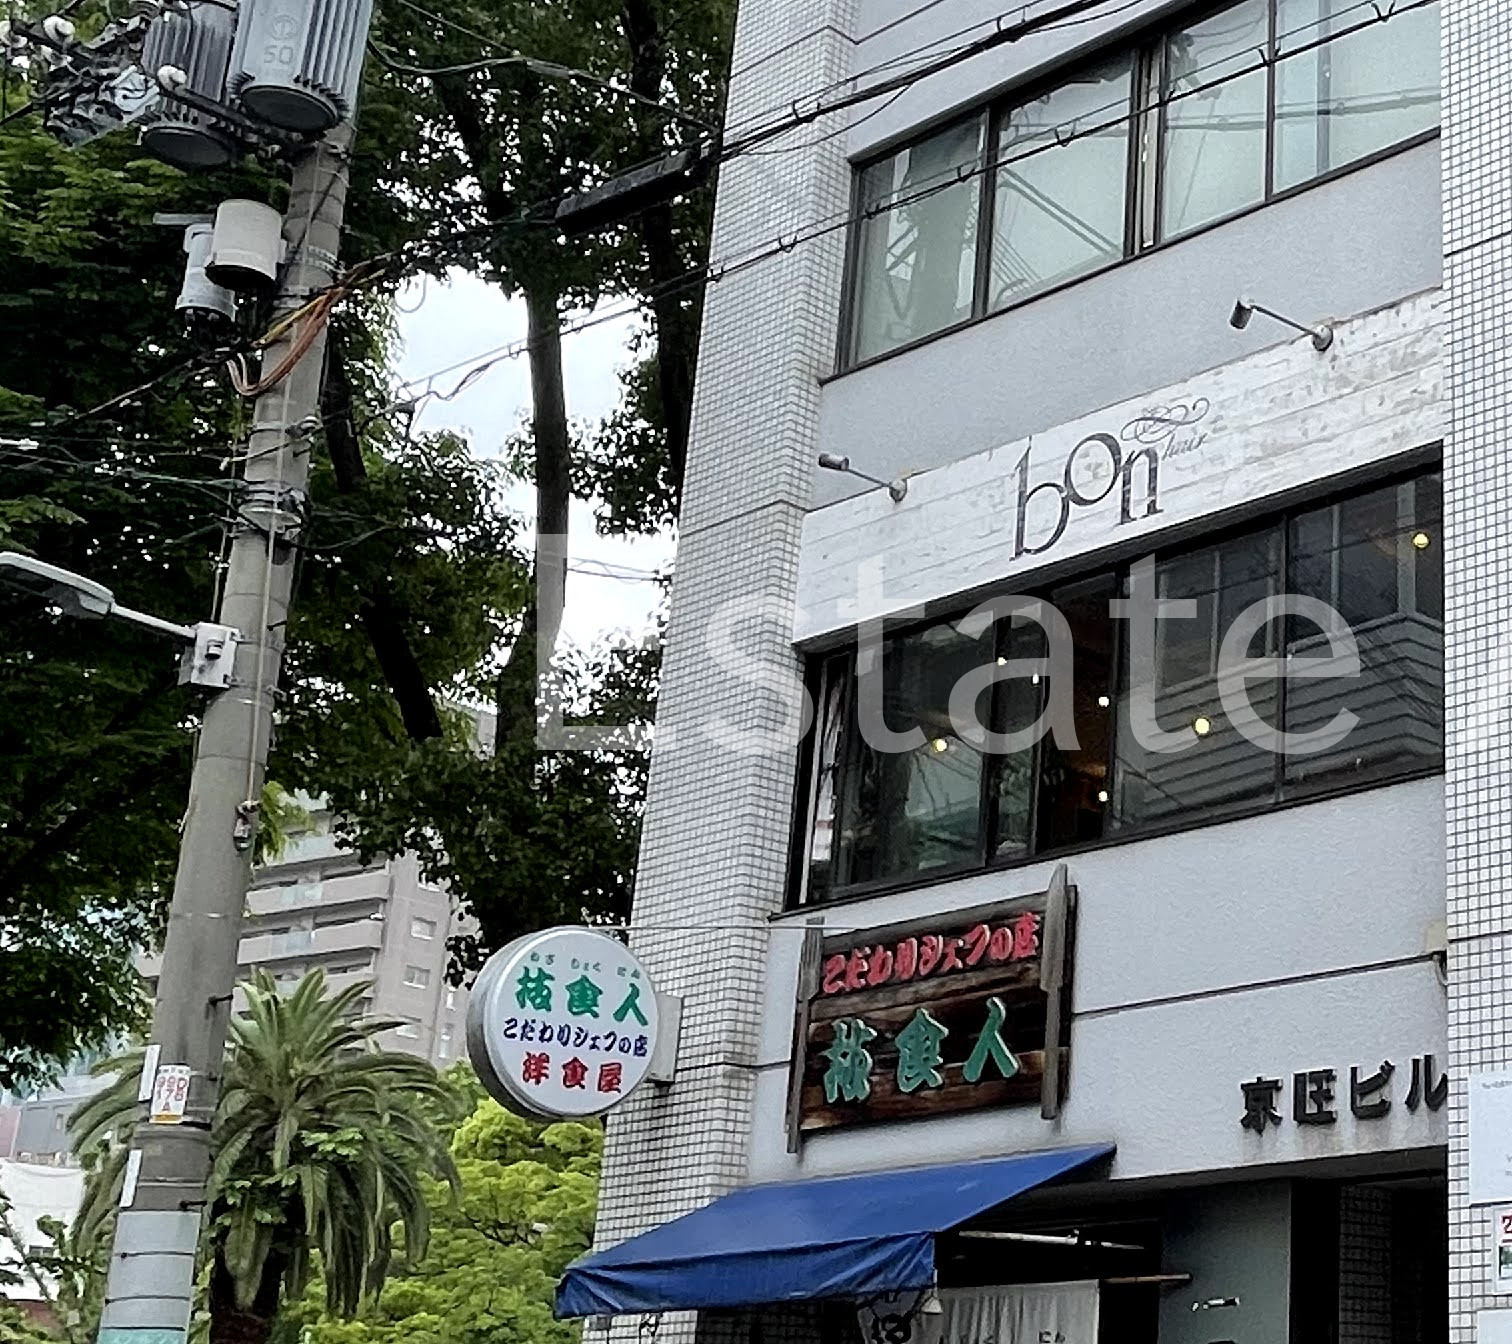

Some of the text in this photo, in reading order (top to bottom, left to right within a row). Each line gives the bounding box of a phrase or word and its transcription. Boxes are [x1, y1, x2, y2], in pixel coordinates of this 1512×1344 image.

[1008, 432, 1164, 562] bon
[822, 911, 1041, 994] こだわりシェフの店
[502, 1016, 649, 1057] こだわりシェフの店
[521, 1050, 623, 1094] 洋食屋
